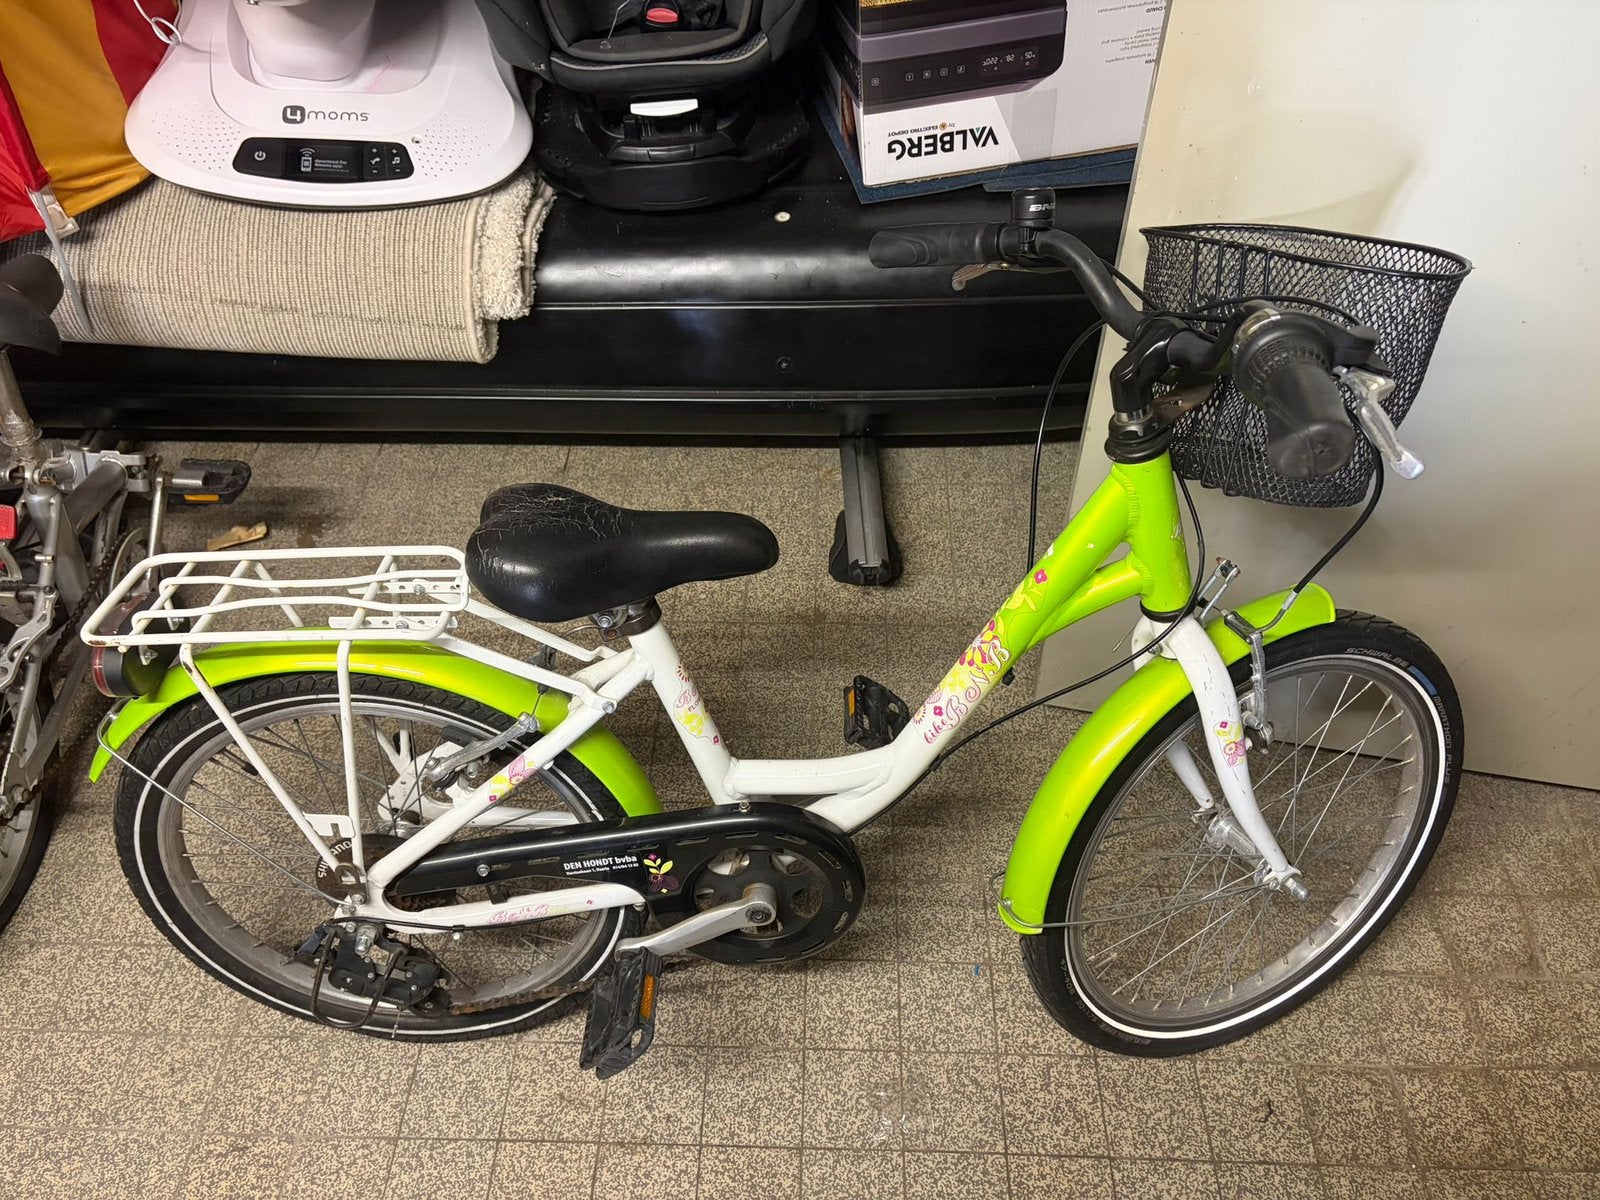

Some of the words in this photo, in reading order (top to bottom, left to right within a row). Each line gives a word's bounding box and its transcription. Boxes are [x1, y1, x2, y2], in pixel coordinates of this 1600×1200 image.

[282, 105, 369, 125] 4moms
[887, 129, 910, 138] DEPOT
[910, 124, 938, 134] ELECTRO
[887, 125, 1000, 161] VALBERG
[1344, 647, 1411, 668] SCHWALBE
[923, 720, 948, 744] bike
[1432, 695, 1453, 749] MARATHON
[1444, 755, 1453, 784] PLUS
[563, 861, 582, 871] DEN
[582, 857, 614, 869] HONDT
[614, 855, 638, 864] bvba
